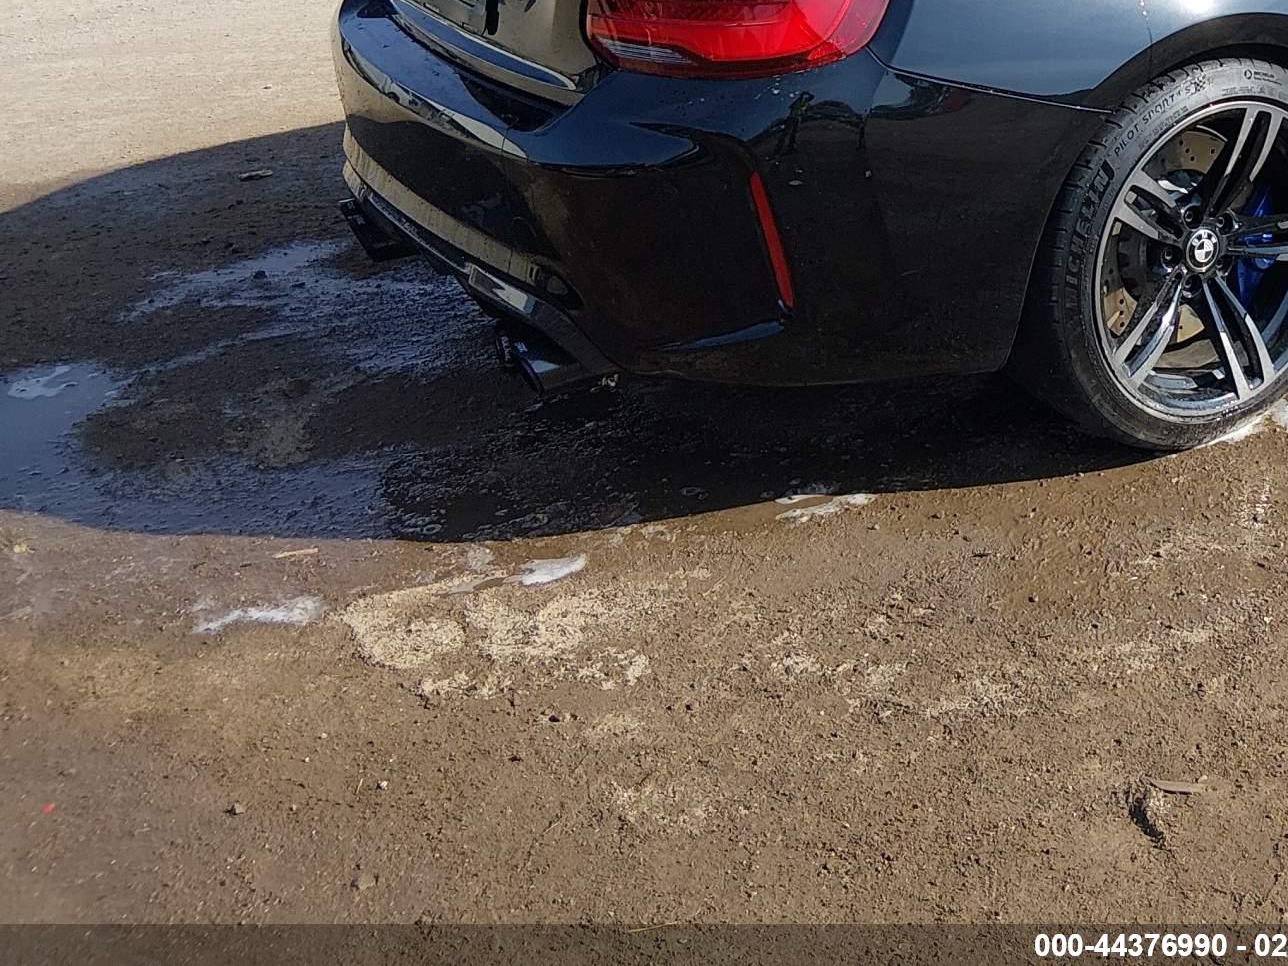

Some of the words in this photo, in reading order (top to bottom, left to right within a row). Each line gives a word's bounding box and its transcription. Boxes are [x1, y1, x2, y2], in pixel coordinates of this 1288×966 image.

[1113, 122, 1140, 156] PILOT
[1142, 93, 1175, 125] SPORT
[1065, 167, 1110, 309] MICHELIN
